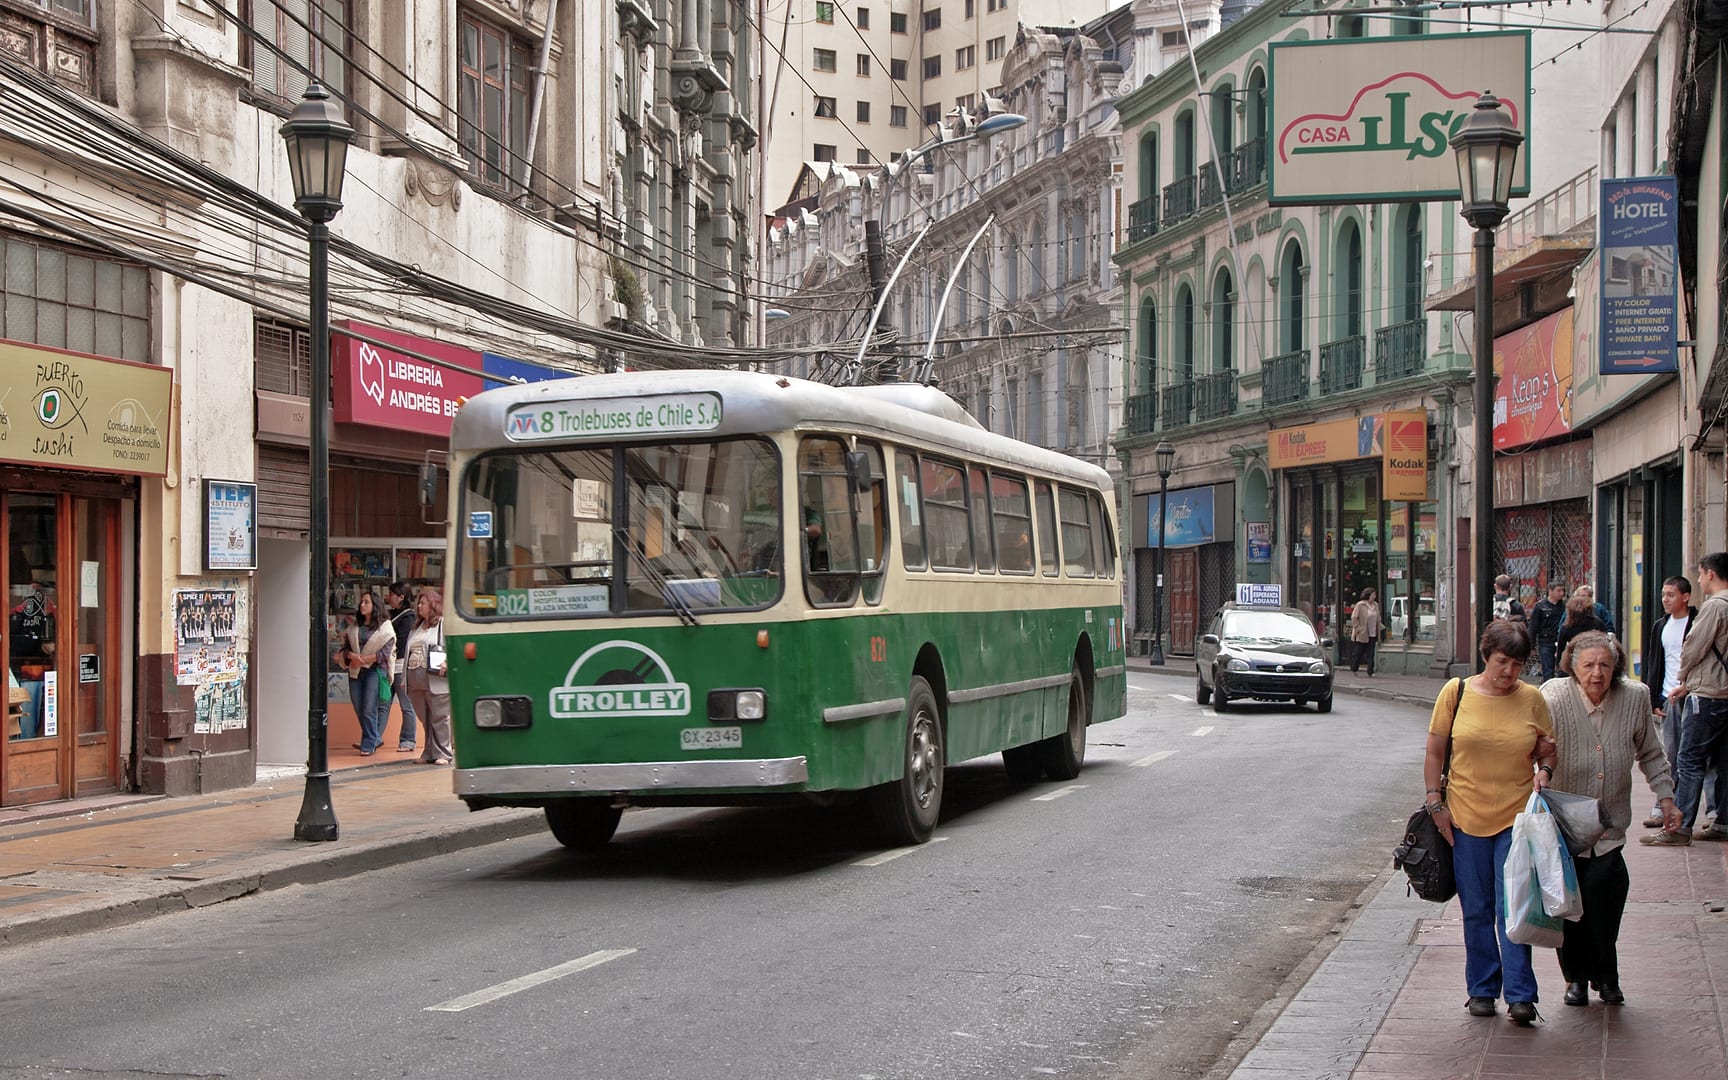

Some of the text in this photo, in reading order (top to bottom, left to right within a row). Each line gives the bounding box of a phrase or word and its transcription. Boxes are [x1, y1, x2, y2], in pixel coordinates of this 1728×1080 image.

[1299, 126, 1350, 144] CASA
[1632, 186, 1673, 201] BREAKFAST
[1614, 203, 1668, 219] HOTEL
[1616, 325, 1636, 333] BAÑO
[388, 359, 443, 388] LIBRERÍA
[389, 389, 440, 415] ANDRÉS
[540, 411, 554, 433] 8
[559, 409, 631, 433] Trolebuses
[636, 406, 652, 428] de
[658, 404, 693, 426] Chile
[107, 419, 157, 435] Comida para llevar
[33, 432, 74, 457] sushi
[103, 433, 131, 446] Despacho
[136, 438, 161, 449] domicilio
[1289, 430, 1306, 443] Kodak
[113, 450, 129, 460] FONO:
[1296, 440, 1326, 457] EXPRESS
[1390, 459, 1424, 469] Kodak
[533, 597, 567, 605] HOSPITAL
[1241, 585, 1252, 603] 61
[499, 595, 528, 615] 802
[534, 603, 588, 612] PLAZA VICTORIA
[870, 636, 887, 663] 821
[557, 690, 684, 712] TROLLEY
